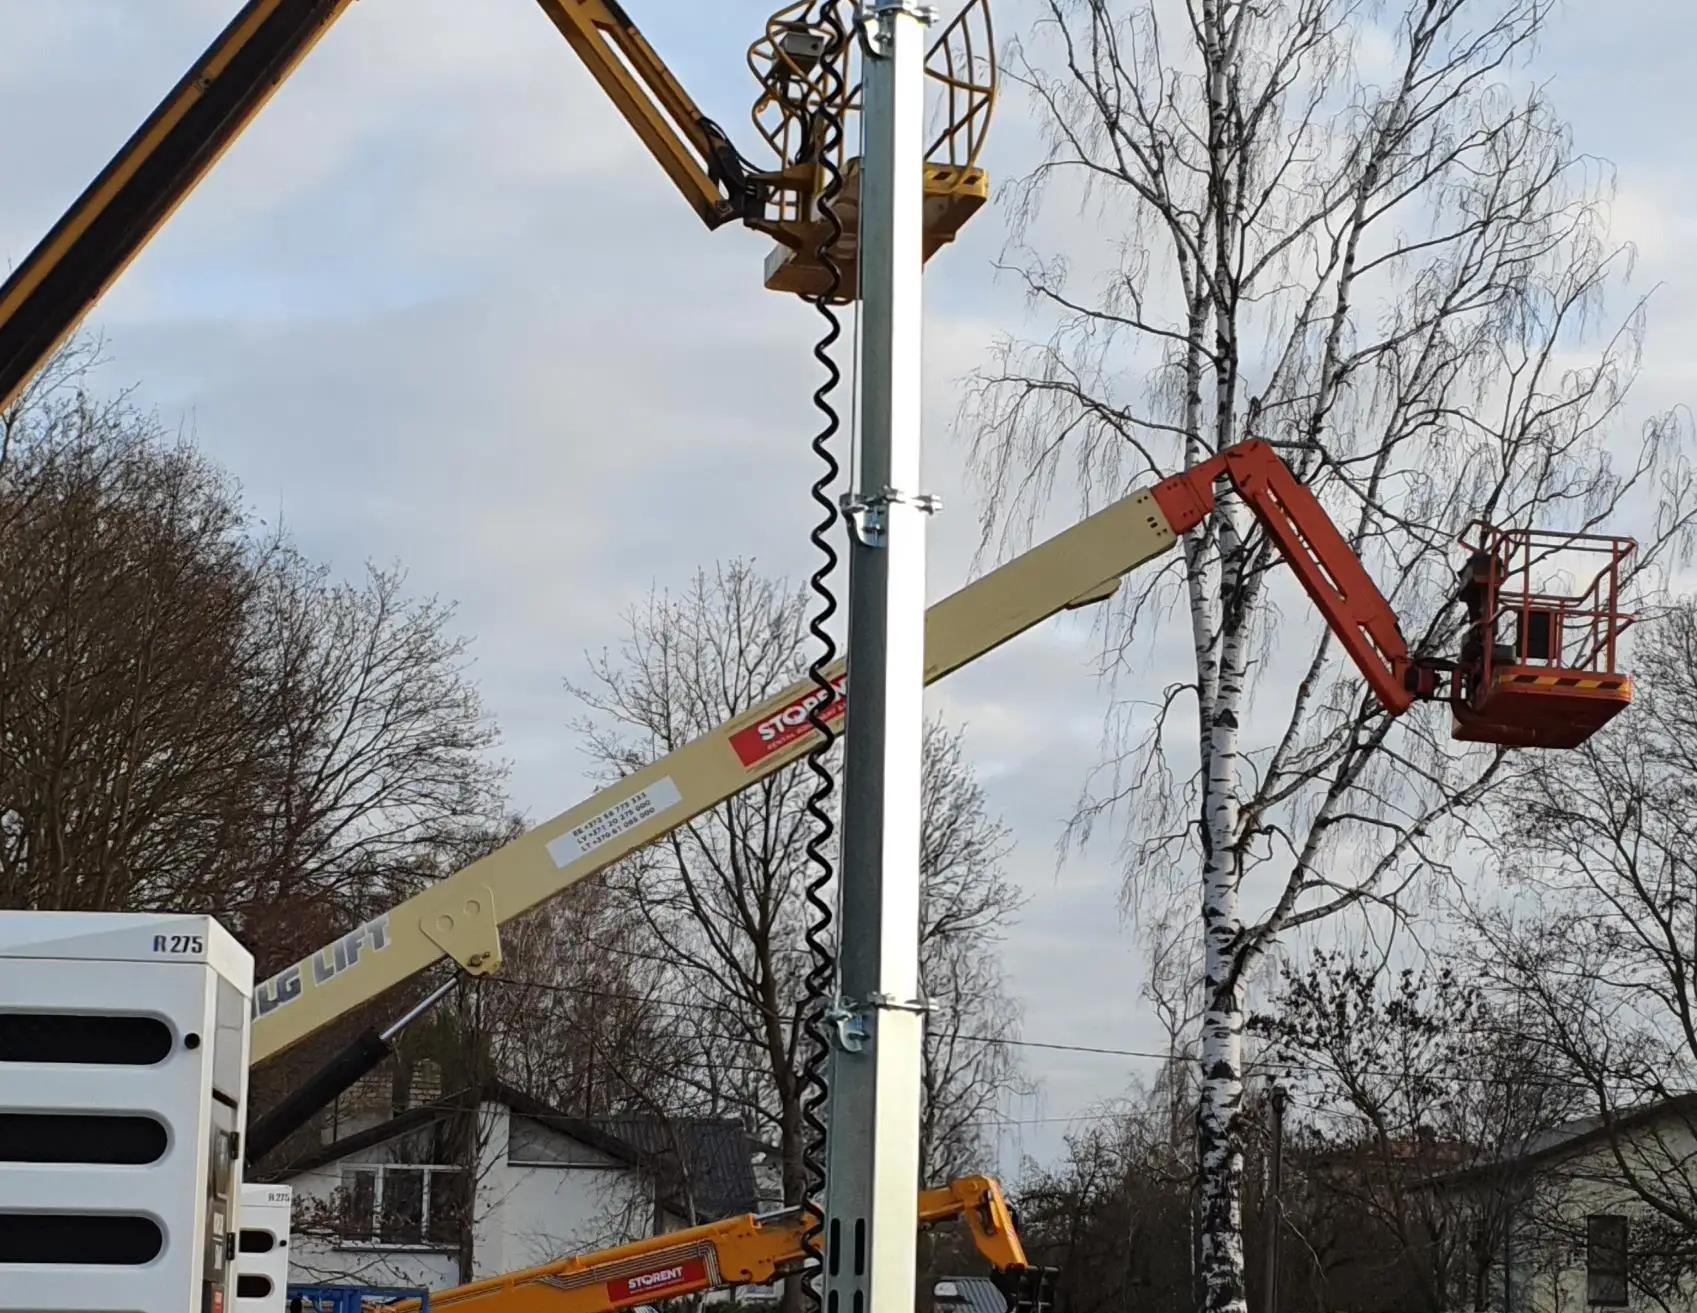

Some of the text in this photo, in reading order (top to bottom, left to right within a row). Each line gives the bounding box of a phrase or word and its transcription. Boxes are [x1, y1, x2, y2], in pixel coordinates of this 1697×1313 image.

[757, 676, 847, 741] STOREN
[577, 834, 587, 844] LV
[607, 817, 619, 827] 20
[635, 799, 651, 811] 000
[581, 842, 590, 851] LT
[639, 807, 655, 819] 000
[153, 934, 203, 954] R 275
[312, 912, 391, 987] LIFT
[628, 1267, 683, 1289] STORENT
